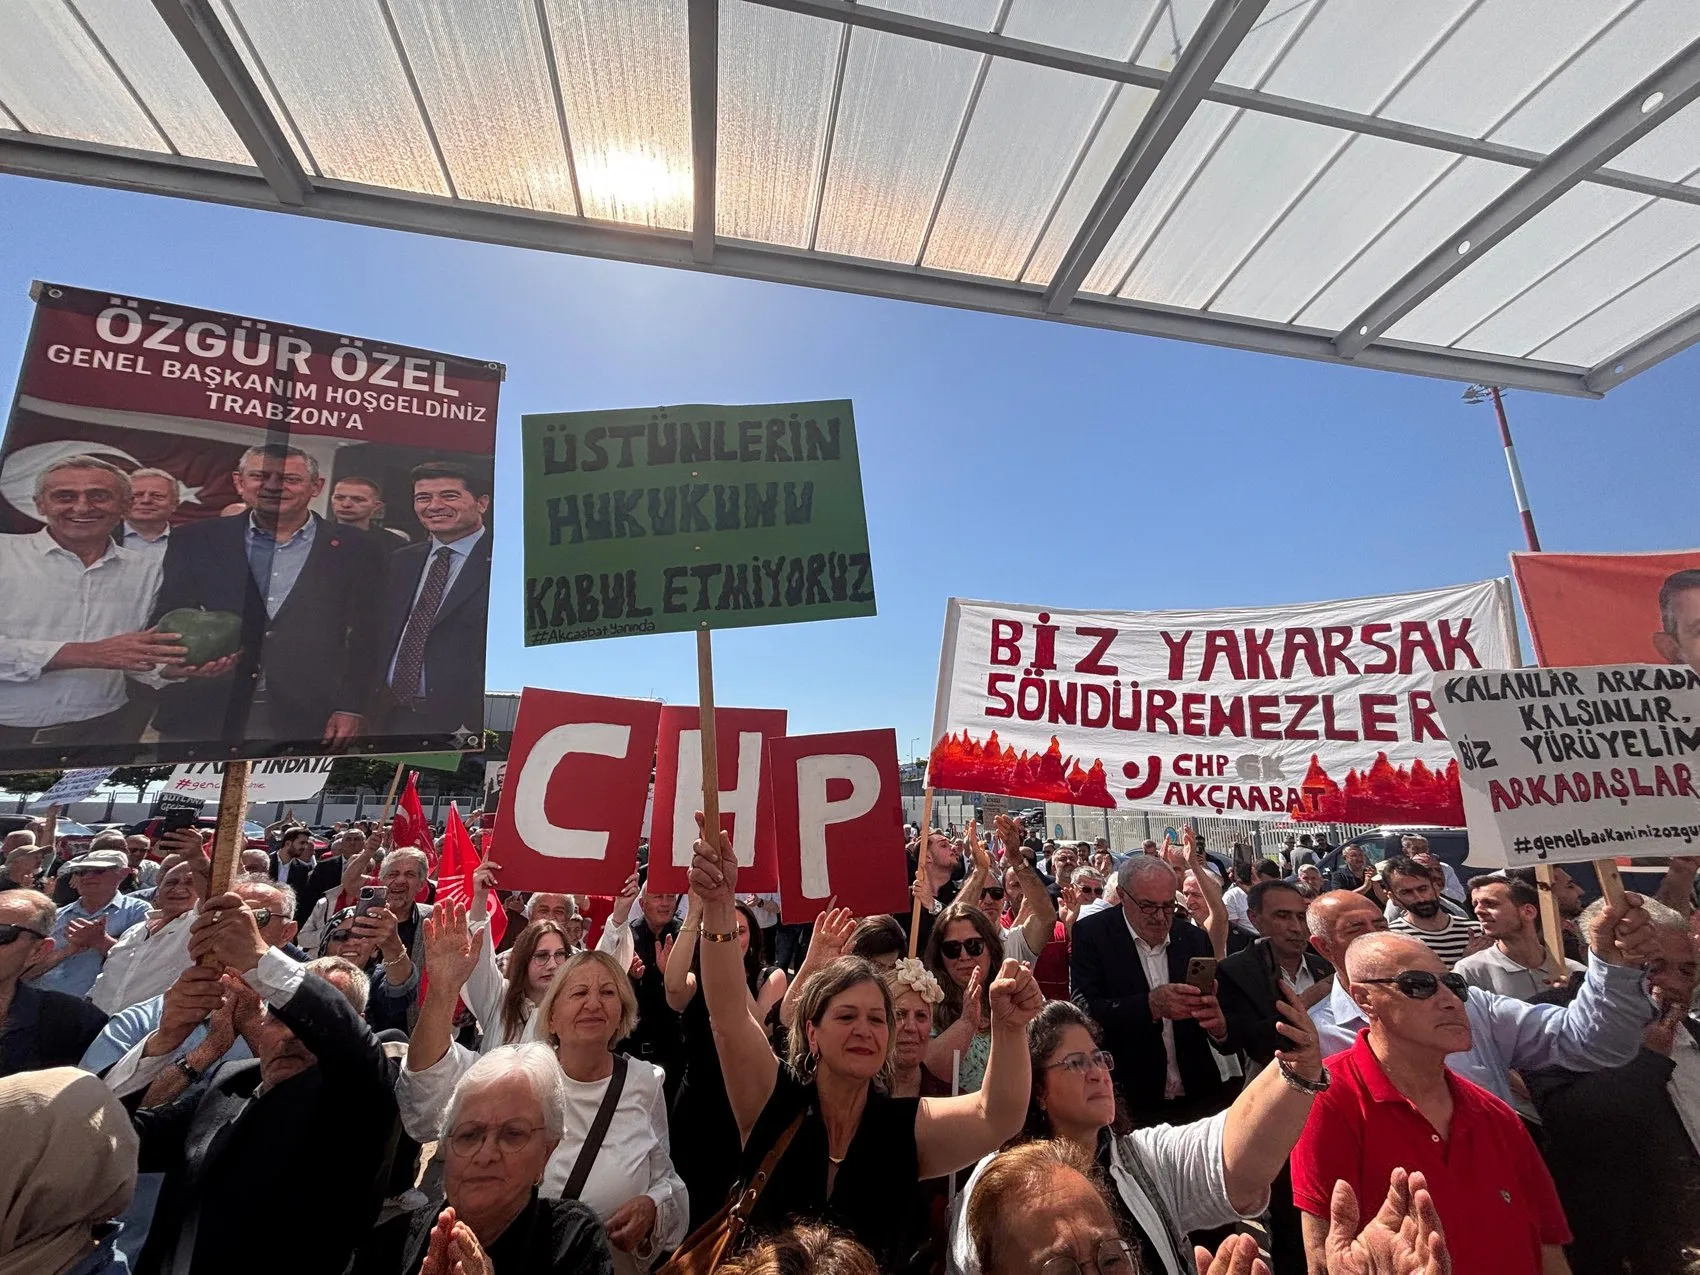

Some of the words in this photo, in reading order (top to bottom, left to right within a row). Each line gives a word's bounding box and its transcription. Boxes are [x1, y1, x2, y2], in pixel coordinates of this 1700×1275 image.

[96, 297, 312, 375] ÖZGÜR
[331, 337, 460, 397] ÖZEL
[47, 343, 151, 375] GENEL
[161, 359, 317, 404] BAŞKANIM
[326, 385, 487, 423] HOŞGELDİNİZ
[206, 391, 363, 431] TRABZON'A
[543, 412, 841, 475] ÜSTÜNLERİN
[546, 481, 814, 545] HUKUKUNU
[526, 569, 653, 630] KABUL
[662, 551, 875, 614] ETMİYORUZ
[989, 612, 1119, 676] BİZ
[1160, 618, 1483, 682] YAKARSAK
[984, 668, 1449, 744] SÖNDÜREMEZLER
[1444, 670, 1584, 704] KALANLAR
[1519, 696, 1691, 731] KALSINLAR,
[1172, 753, 1230, 777] CHP
[1457, 734, 1498, 771] BİZ
[1520, 725, 1700, 764] YÜRÜYELİM
[1163, 781, 1326, 815] AKÇAABAT
[1488, 763, 1700, 813] ARKADAŞLAR
